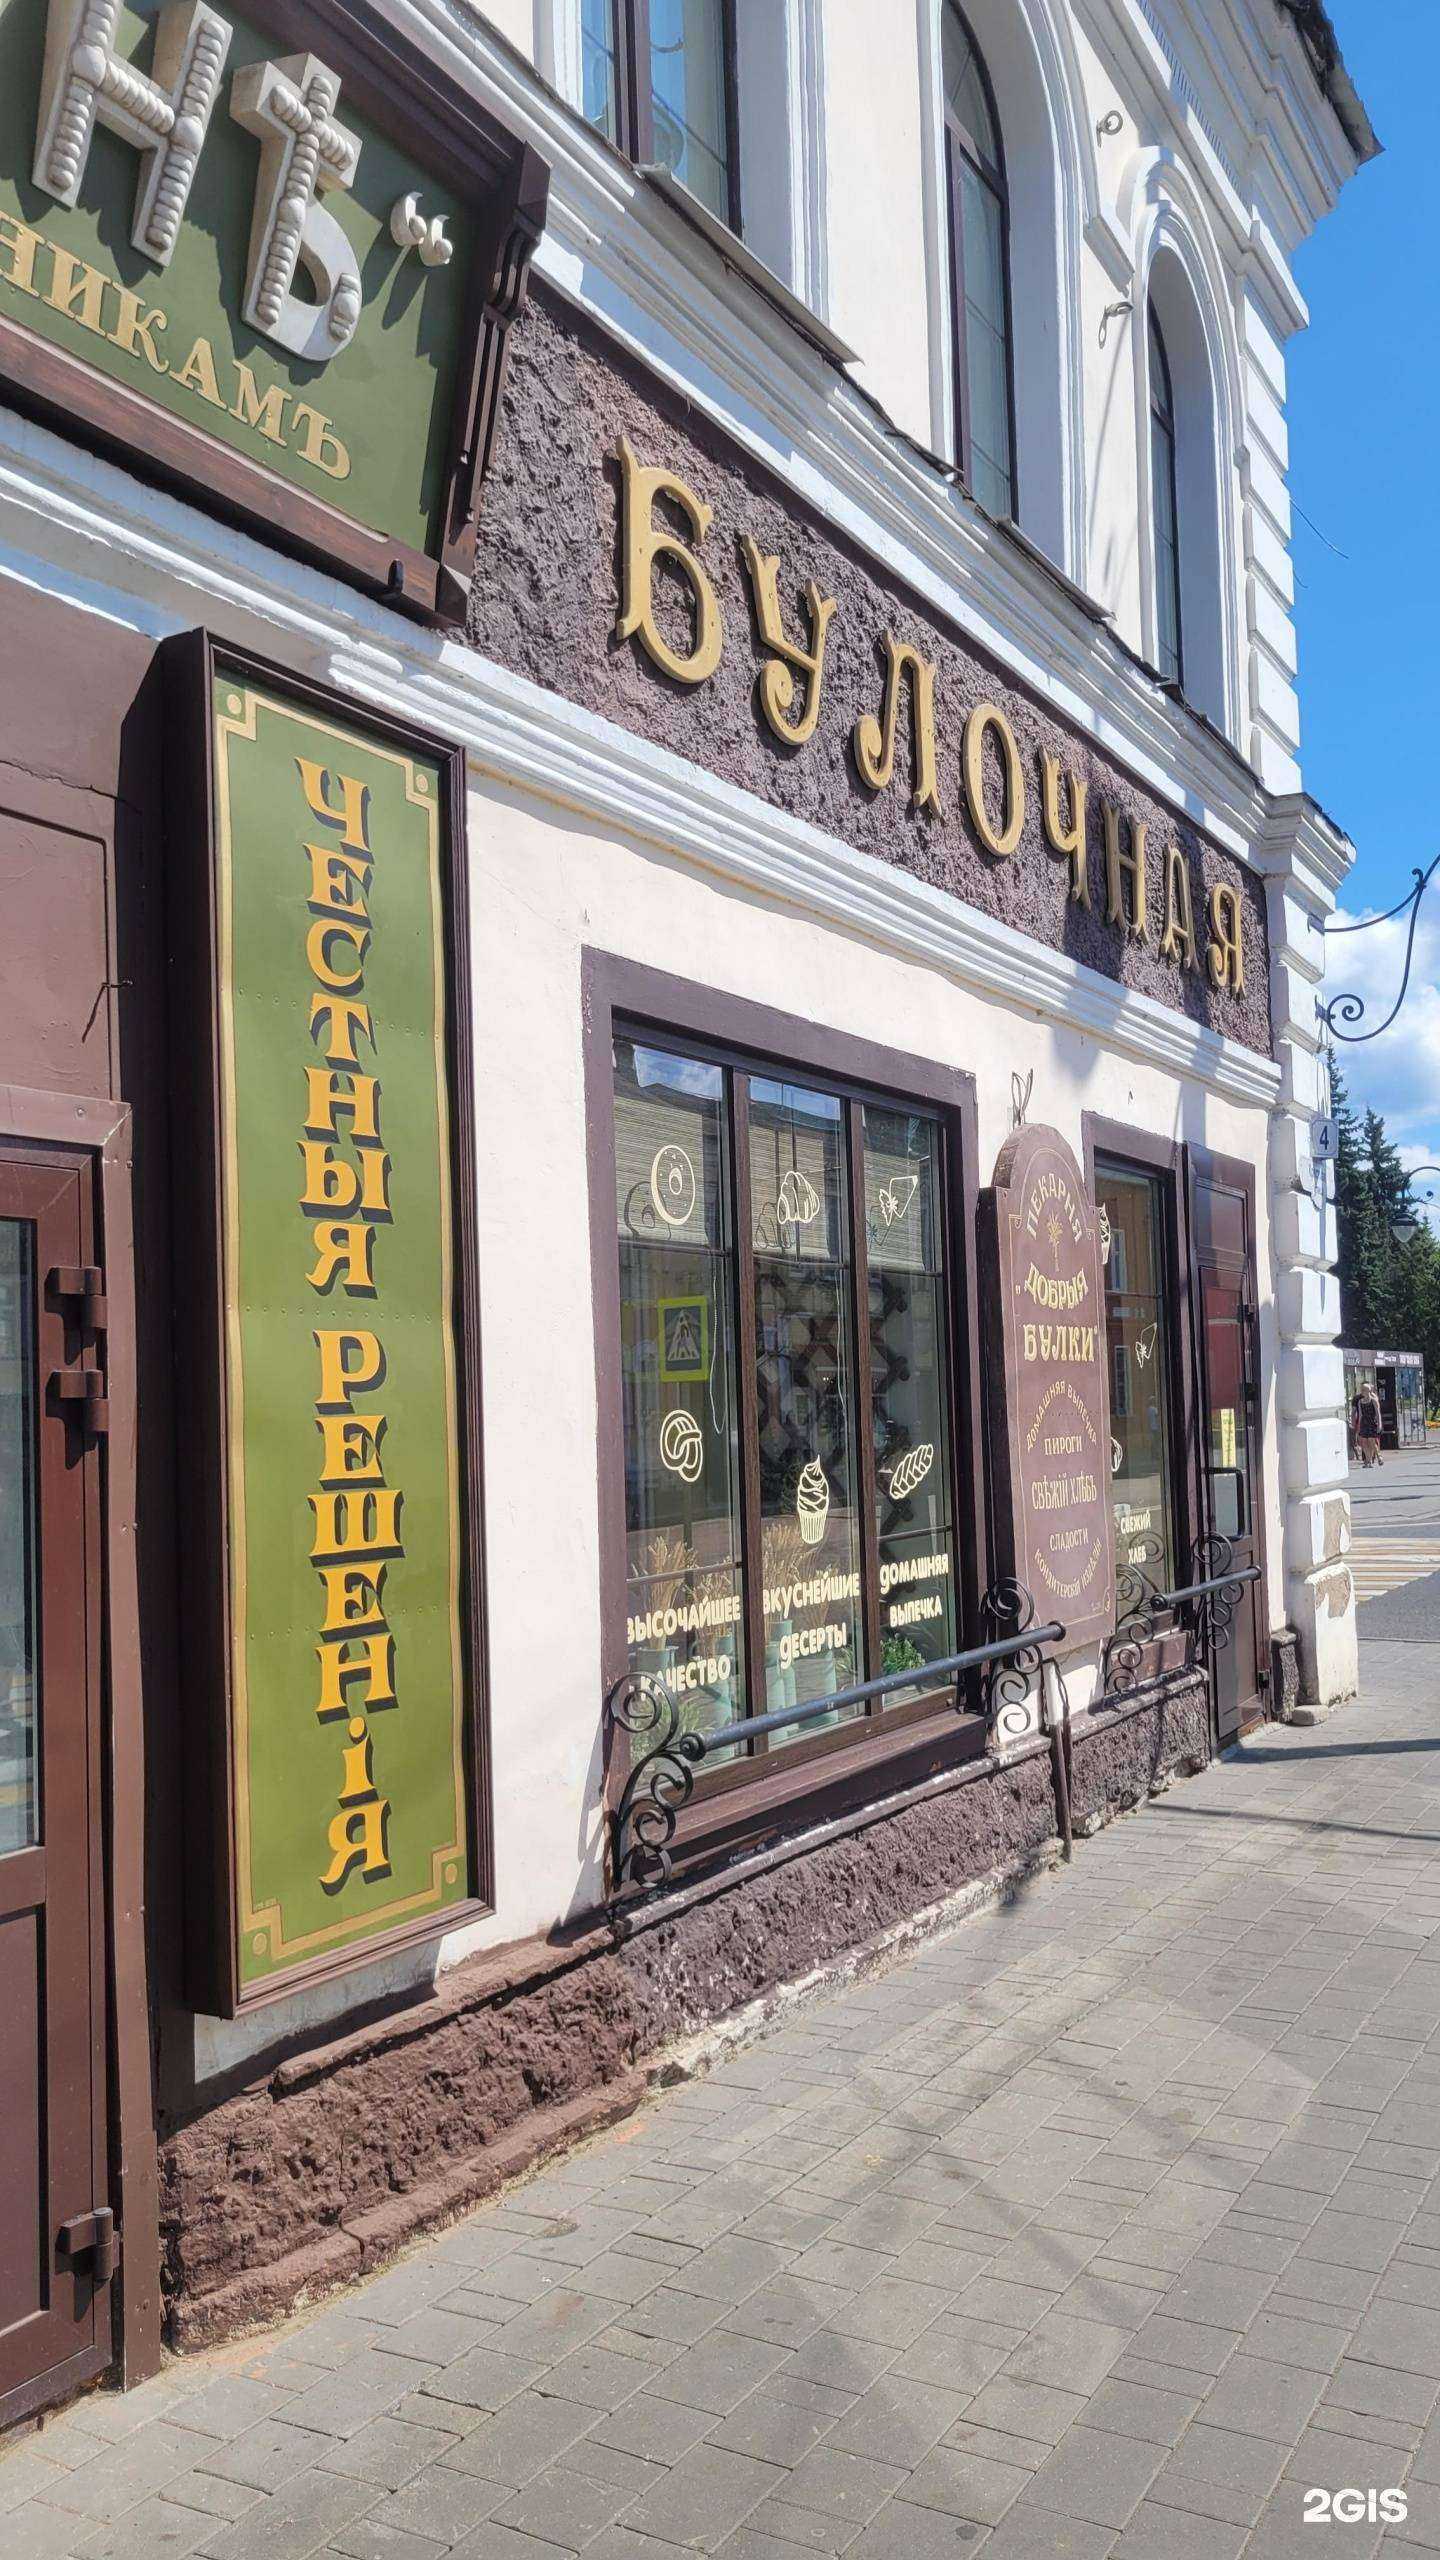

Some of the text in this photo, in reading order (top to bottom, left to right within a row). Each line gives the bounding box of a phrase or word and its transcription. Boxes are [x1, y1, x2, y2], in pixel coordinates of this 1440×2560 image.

[616, 434, 1246, 1000] БУЛОЧНАЯ
[294, 756, 394, 1299] ЧЕСТНЫЯ
[1319, 1125, 1330, 1151] 4
[1026, 1173, 1083, 1242] ПЕКАРНЯ
[1026, 1381, 1097, 1453] ДОМАШНЯЯ ВЫПЕЧКА
[1044, 1435, 1083, 1456] ПИРОГИ
[1120, 1509, 1151, 1534] СВЕЖИЙ
[1049, 1527, 1089, 1552] СЛАДОСТИ
[1127, 1544, 1147, 1565] ХЛЕБ
[762, 1570, 860, 1620] ВКУСНЕЙШИЕ
[889, 1594, 943, 1628] ВЫПЕЧКА
